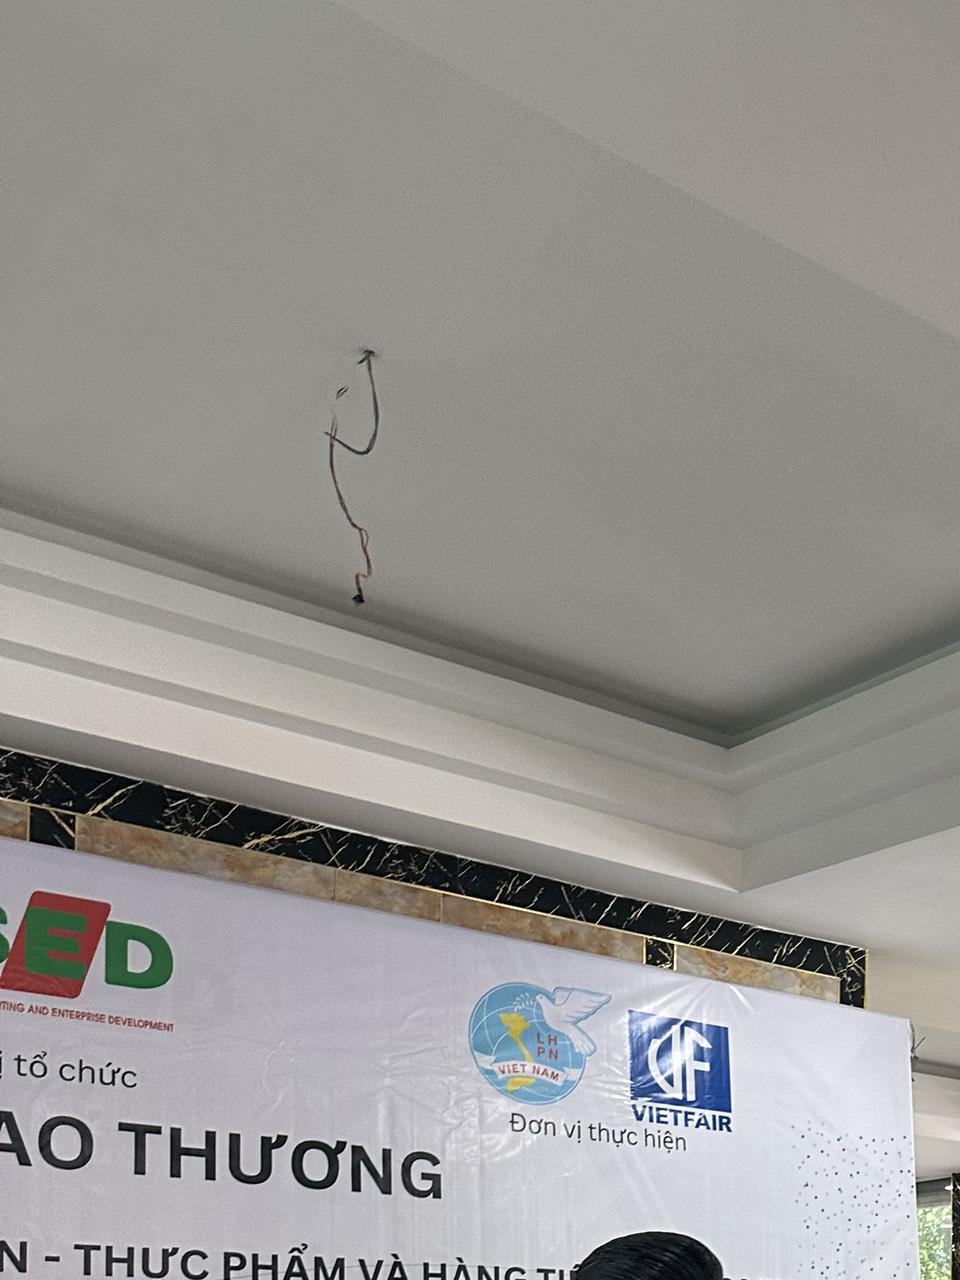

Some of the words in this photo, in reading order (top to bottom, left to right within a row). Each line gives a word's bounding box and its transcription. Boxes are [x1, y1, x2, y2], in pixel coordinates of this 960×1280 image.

[0, 905, 174, 989] ED
[28, 1005, 49, 1015] AND
[51, 1008, 106, 1023] ENTERPRISE
[108, 1015, 174, 1032] DEVELOPMENT
[14, 1051, 48, 1078] tổ
[59, 1059, 137, 1088] chức
[532, 1066, 561, 1081] NAM
[509, 1113, 556, 1136] Đơn
[563, 1120, 582, 1143] vị
[588, 1123, 638, 1148] thực
[645, 1128, 687, 1153] hiện
[632, 1104, 732, 1132] VIETFAIR
[118, 1122, 442, 1199] THƯƠNG
